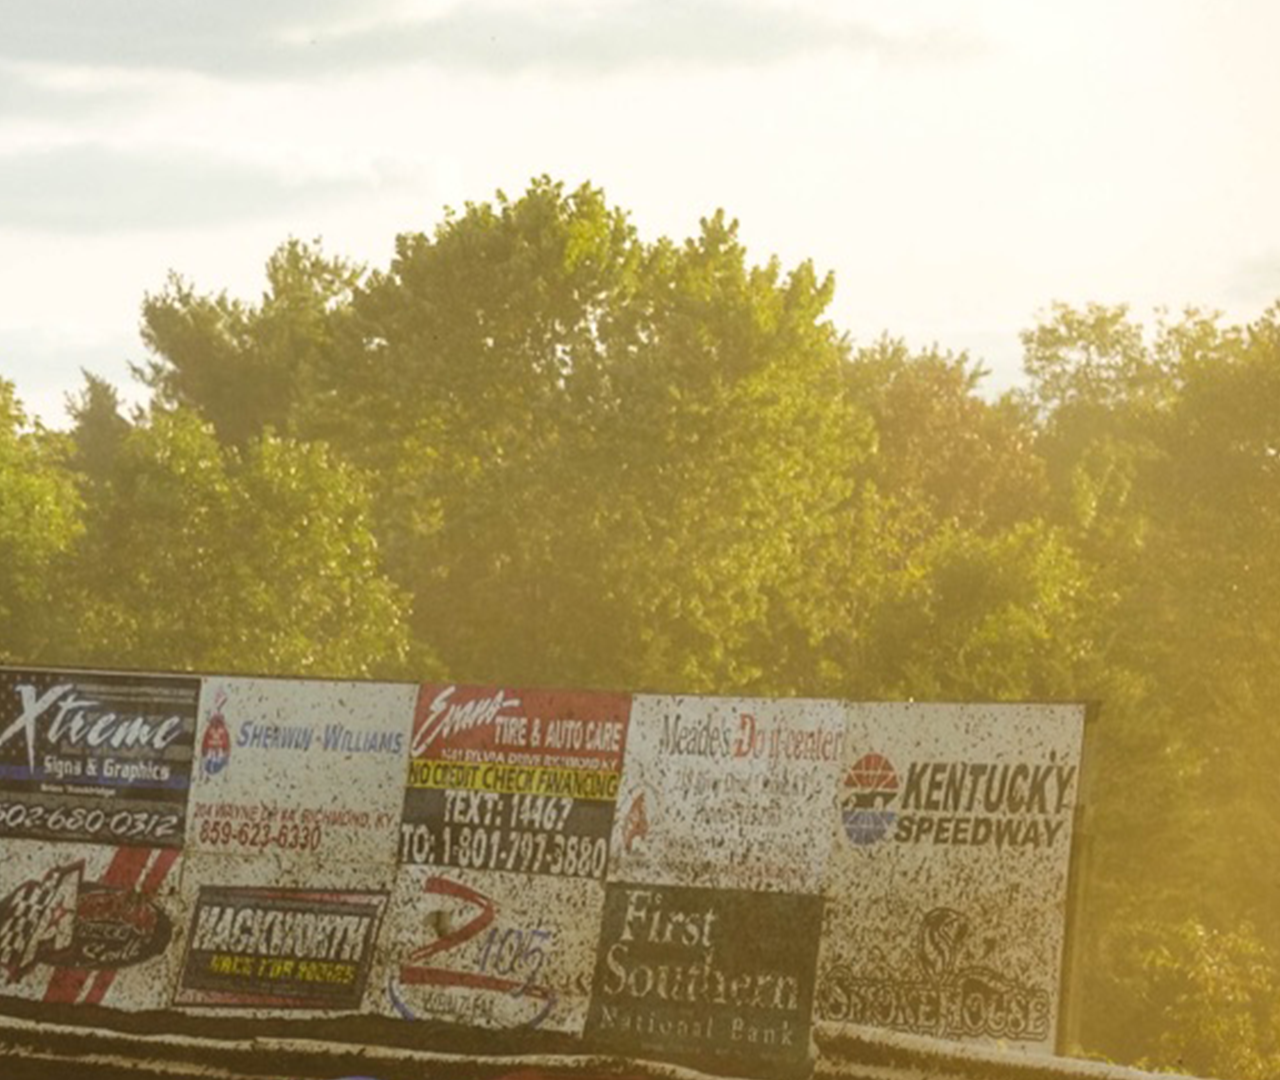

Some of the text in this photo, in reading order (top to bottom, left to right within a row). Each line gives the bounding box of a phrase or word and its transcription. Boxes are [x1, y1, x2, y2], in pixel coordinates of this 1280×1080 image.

[494, 715, 528, 745] TIRE
[545, 719, 583, 750] AUTO
[585, 721, 624, 752] CARE
[658, 713, 731, 759] Meade's
[734, 713, 765, 760] Do
[43, 755, 172, 783] Signs & Graphics
[408, 761, 619, 798] NO CREDIT CHECK FINANCING
[901, 761, 1078, 815] KENTUCKY
[443, 789, 574, 831] TEXT: 14467
[199, 819, 321, 851] 859-623-6330
[401, 823, 436, 864] TO:
[893, 815, 1064, 849] SPEEDWAY
[192, 905, 372, 962] HACKWORTH
[620, 890, 716, 947] First
[603, 942, 799, 1011] Southern
[599, 1004, 794, 1046] National Bank
